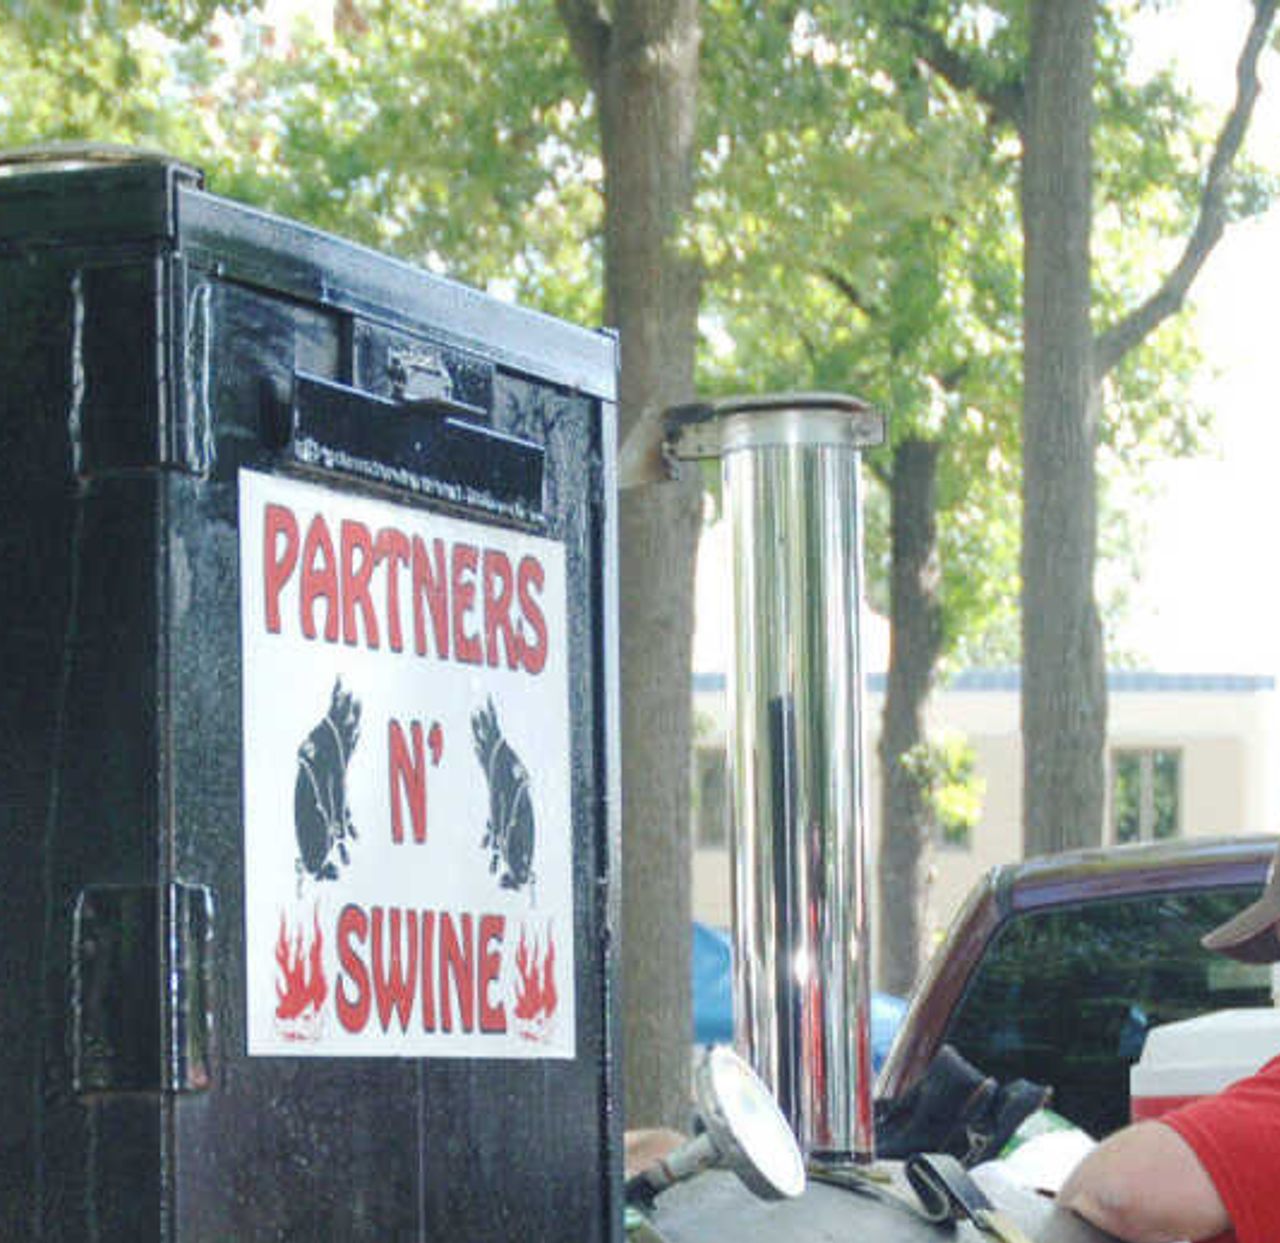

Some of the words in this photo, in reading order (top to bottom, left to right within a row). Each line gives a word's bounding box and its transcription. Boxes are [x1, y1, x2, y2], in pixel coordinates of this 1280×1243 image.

[263, 501, 549, 676] PARTNERS
[389, 717, 444, 845] N'
[335, 903, 509, 1036] SWINE
